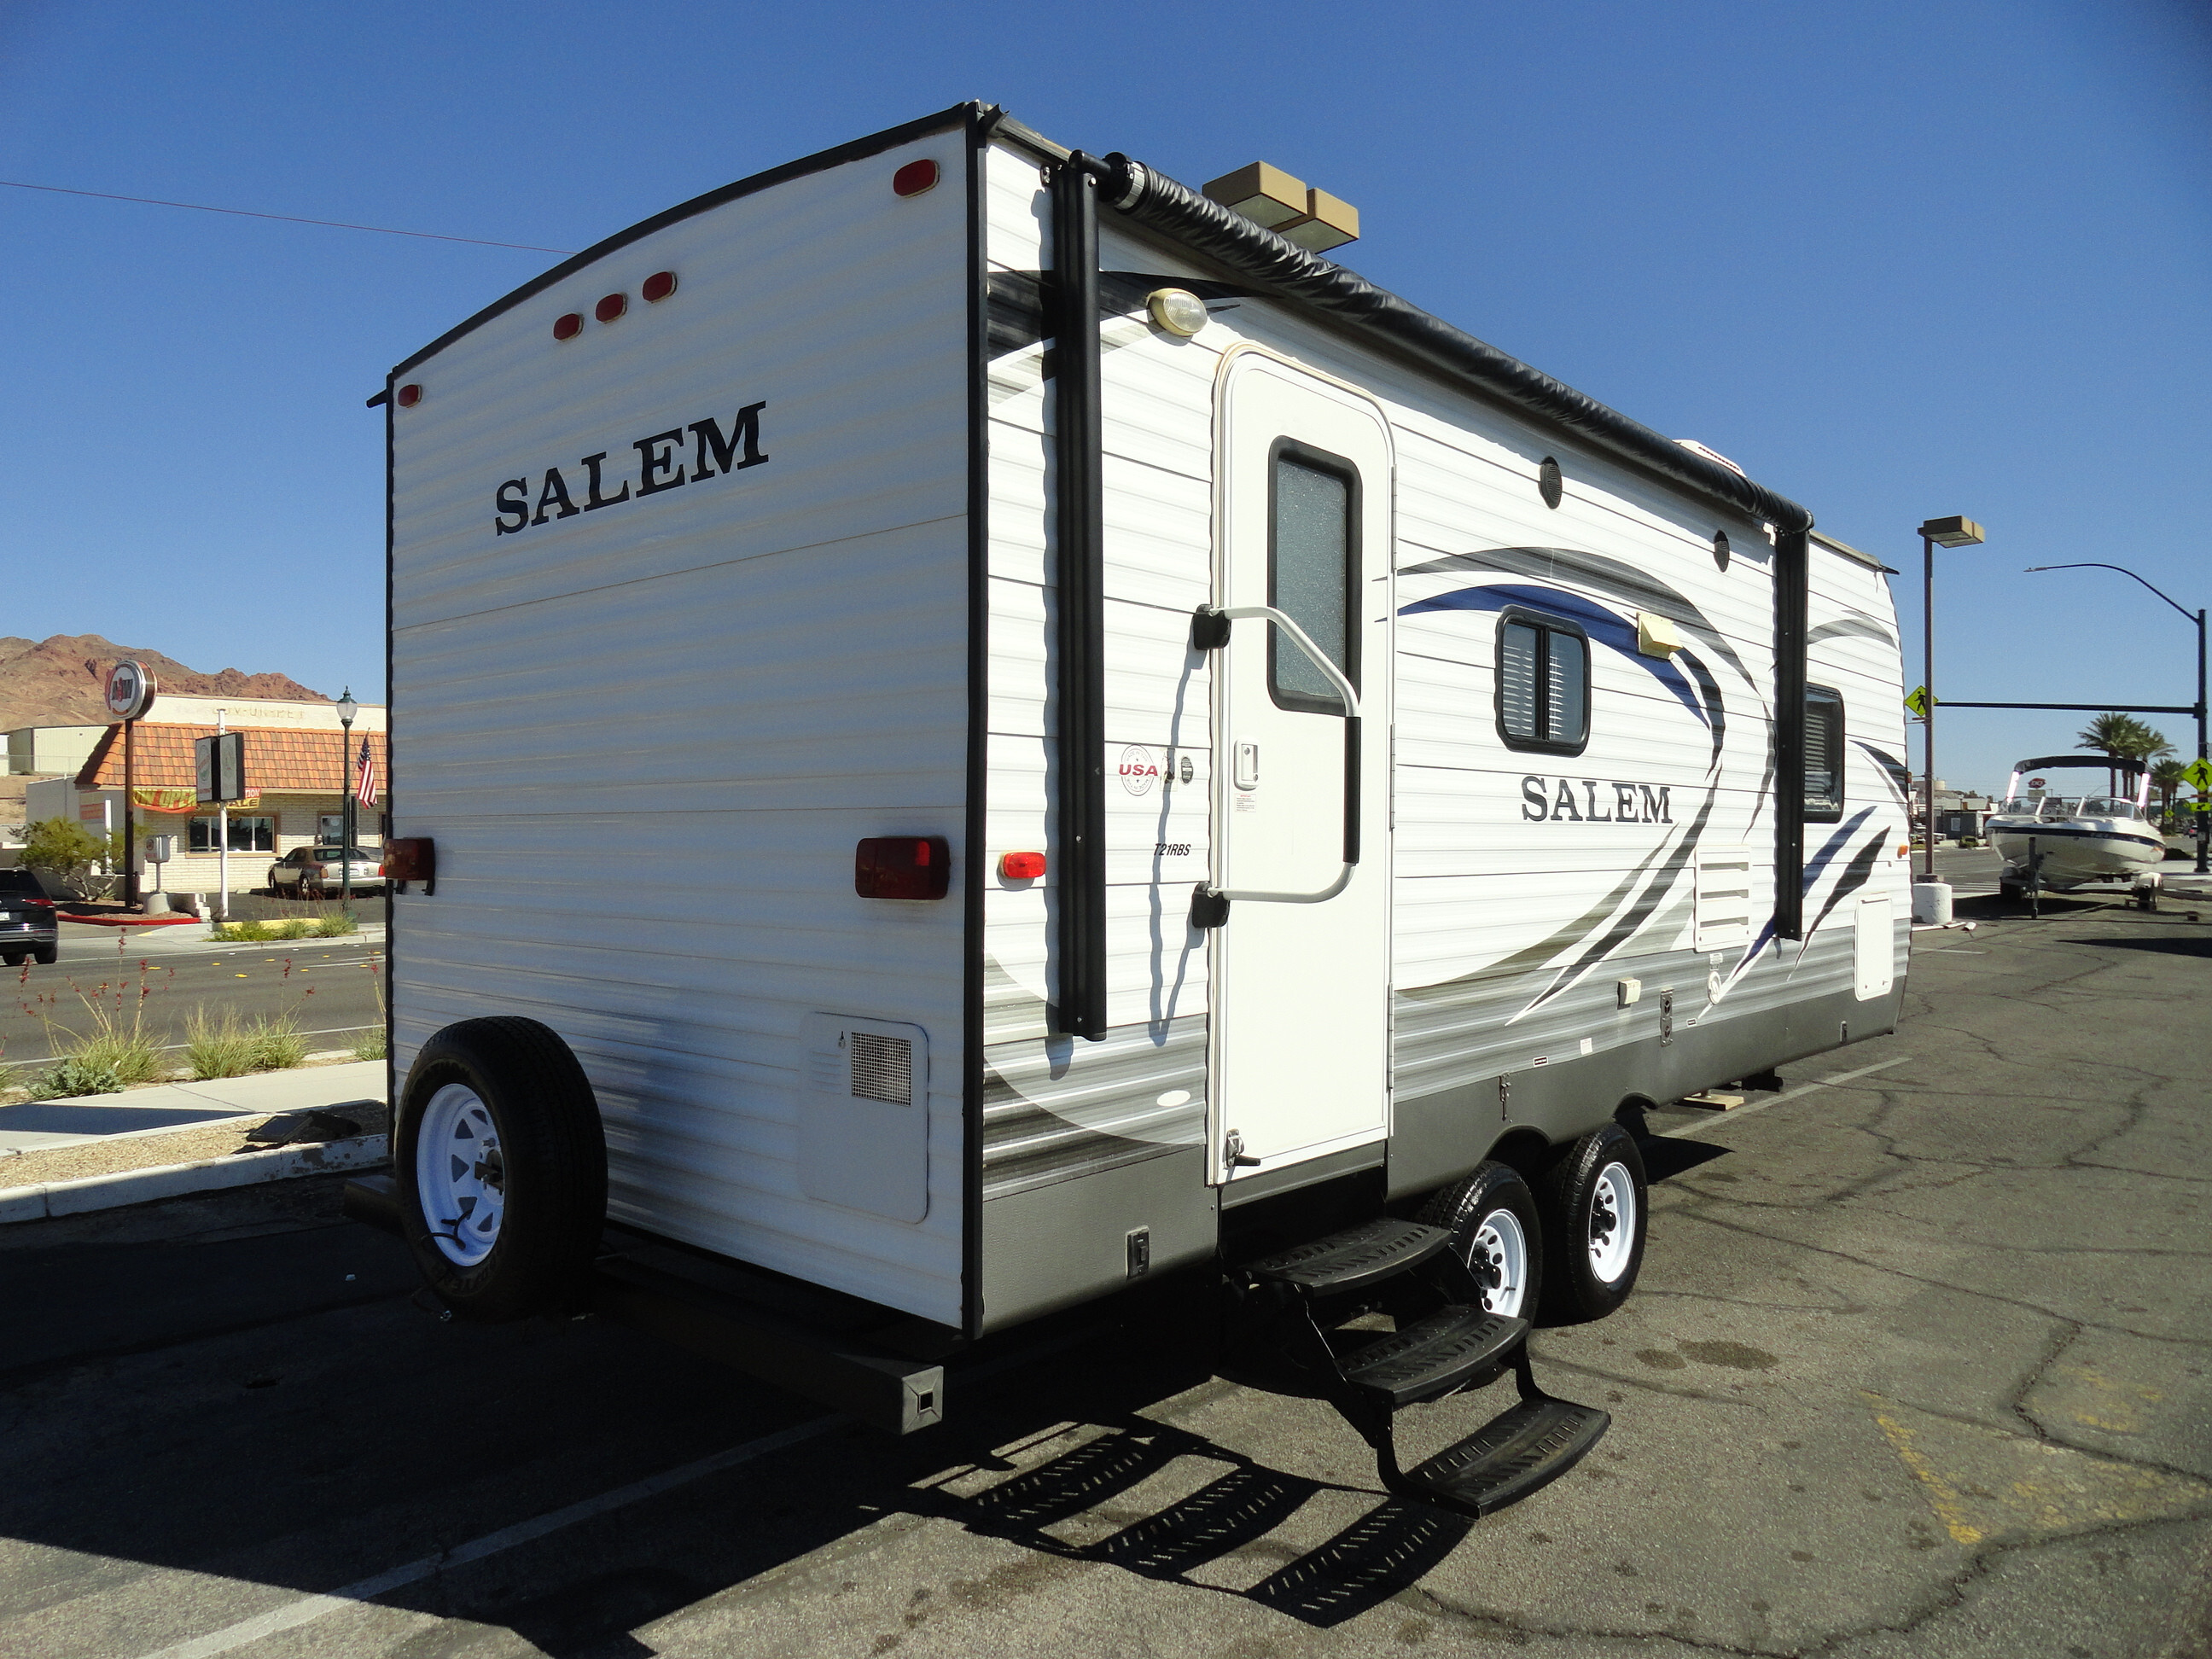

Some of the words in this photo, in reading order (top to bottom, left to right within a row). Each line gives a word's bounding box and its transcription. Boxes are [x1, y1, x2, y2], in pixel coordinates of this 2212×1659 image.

[494, 399, 769, 537] SALEM
[1119, 763, 1158, 777] USA
[1521, 775, 1674, 824] SALEM
[1154, 843, 1191, 856] T21RBS
